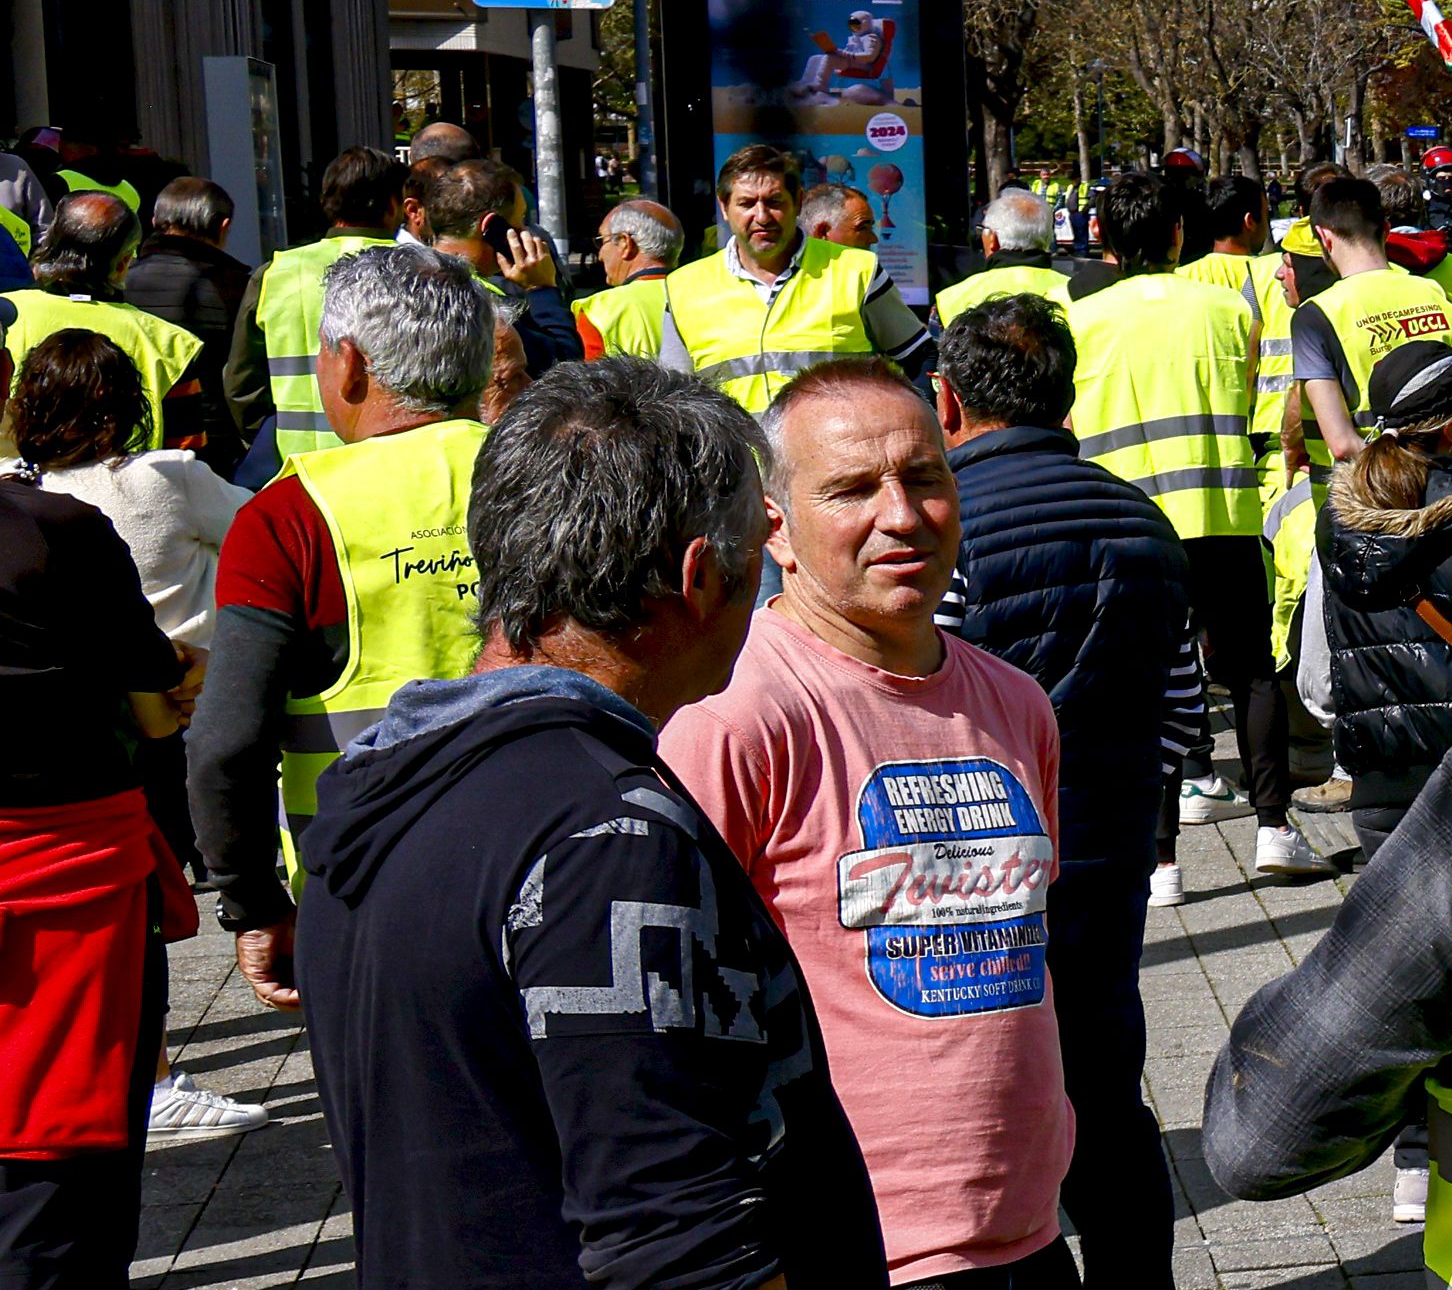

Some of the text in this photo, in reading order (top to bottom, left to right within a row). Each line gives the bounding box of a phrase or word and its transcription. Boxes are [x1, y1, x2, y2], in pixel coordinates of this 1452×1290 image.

[869, 125, 906, 138] 2024
[1356, 313, 1381, 328] UNION
[1382, 311, 1393, 321] DE
[1407, 315, 1447, 336] UCCL
[380, 547, 474, 584] Treviño
[882, 770, 1008, 807] REFRESHING
[894, 802, 1018, 836] ENERGY DRINK
[933, 842, 995, 860] Delicious
[931, 907, 954, 919] 100%
[886, 934, 960, 960] SUPER
[930, 962, 977, 982] serve
[921, 984, 981, 1004] KENTUCKY
[983, 980, 1006, 998] SOFT
[1008, 977, 1033, 994] DRINK
